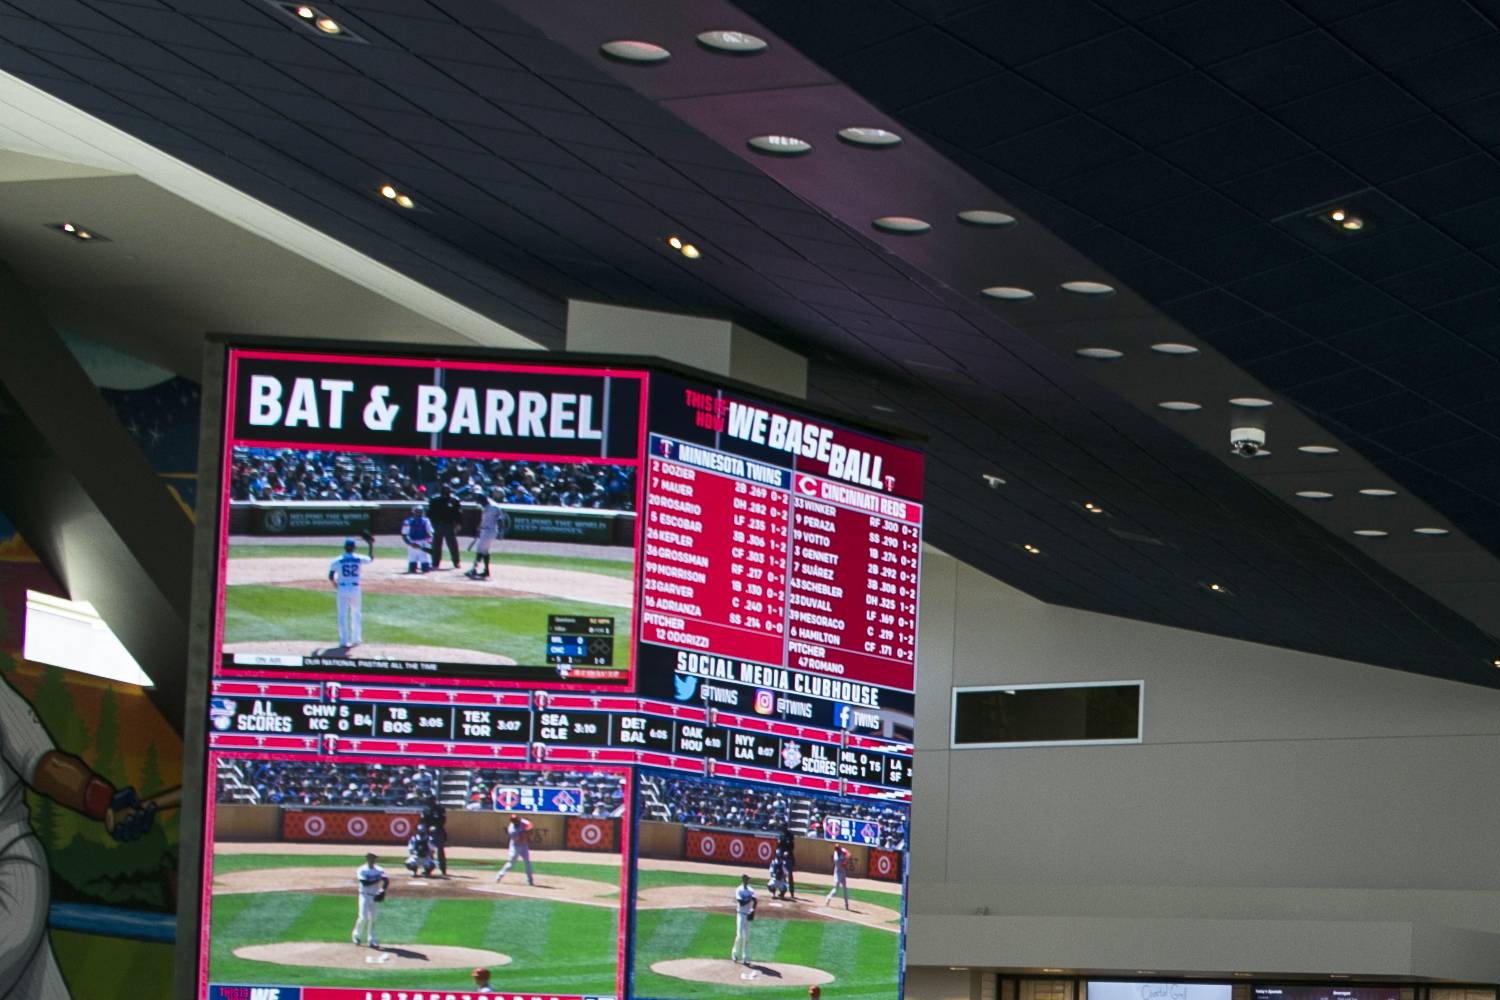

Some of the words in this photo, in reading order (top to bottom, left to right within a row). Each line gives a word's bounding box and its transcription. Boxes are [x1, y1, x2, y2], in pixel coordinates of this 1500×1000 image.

[248, 374, 354, 429] BAT
[362, 384, 399, 431] &
[415, 384, 603, 440] BARREL
[684, 389, 713, 412] THIS
[695, 410, 725, 432] HOW
[727, 401, 768, 445] WE
[768, 413, 834, 464] BASE
[661, 461, 696, 481] DOZIER
[678, 444, 745, 477] MINNESOTA
[746, 462, 782, 486] TWINS
[827, 443, 884, 490] BALL
[660, 479, 694, 498] MAUER
[660, 496, 702, 516] ROSARIO
[804, 498, 836, 517] WINKER
[821, 482, 880, 512] CINCINNATI
[880, 497, 907, 520] REDS
[660, 513, 702, 533] ESCOBAR
[804, 515, 836, 533] PERAZA
[658, 530, 694, 548] KEPLER
[803, 531, 830, 548] VOTTO
[658, 546, 709, 568] GROSSMAN
[802, 547, 839, 566] GENNETT
[658, 563, 706, 584] MORRISON
[656, 580, 694, 598] GARVER
[800, 580, 844, 598] SCHEBLER
[656, 598, 702, 617] ADRIANZA
[800, 595, 832, 612] DUVALL
[643, 612, 685, 630] PITCHER
[800, 610, 846, 630] MESORACO
[666, 630, 710, 648] ODORIZZI
[798, 628, 841, 646] HAMILTON
[788, 641, 826, 658] PITCHER
[304, 658, 320, 666] OUR
[321, 659, 357, 668] NATIONAL
[358, 660, 389, 669] PASTIME
[808, 659, 845, 675] ROMANO
[676, 651, 735, 680] SOCIAL
[740, 662, 789, 690] MEDIA
[794, 672, 879, 706] CLUBHOUSE
[700, 684, 738, 706] @TWINS
[302, 704, 337, 718] CHW
[338, 706, 350, 718] 5
[388, 707, 408, 720] TB
[776, 697, 813, 719] @TWINS
[236, 714, 292, 732] SCORES
[308, 718, 330, 730] KC
[338, 718, 350, 732] 0
[354, 714, 373, 728] B4
[418, 716, 444, 728] 3:05
[462, 710, 492, 724] TEX
[540, 714, 570, 728] SEA
[620, 716, 647, 731] DET
[853, 710, 880, 730] TWINS
[382, 720, 413, 734] BOS
[462, 724, 492, 738] TOR
[496, 720, 522, 732] 3:07
[540, 726, 568, 741] CLE
[574, 722, 598, 734] 3:10
[649, 728, 668, 740] 6:05
[681, 725, 703, 740] OAK
[620, 730, 647, 744] BAL
[680, 738, 703, 752] HOU
[704, 736, 722, 748] 6:10
[734, 734, 756, 748] NYY
[734, 748, 755, 761] LAA
[840, 750, 857, 764] MIL
[801, 758, 837, 776] SCORES
[839, 764, 858, 776] CHC
[868, 760, 882, 772] T5
[890, 758, 902, 771] LA
[890, 770, 902, 783] SF
